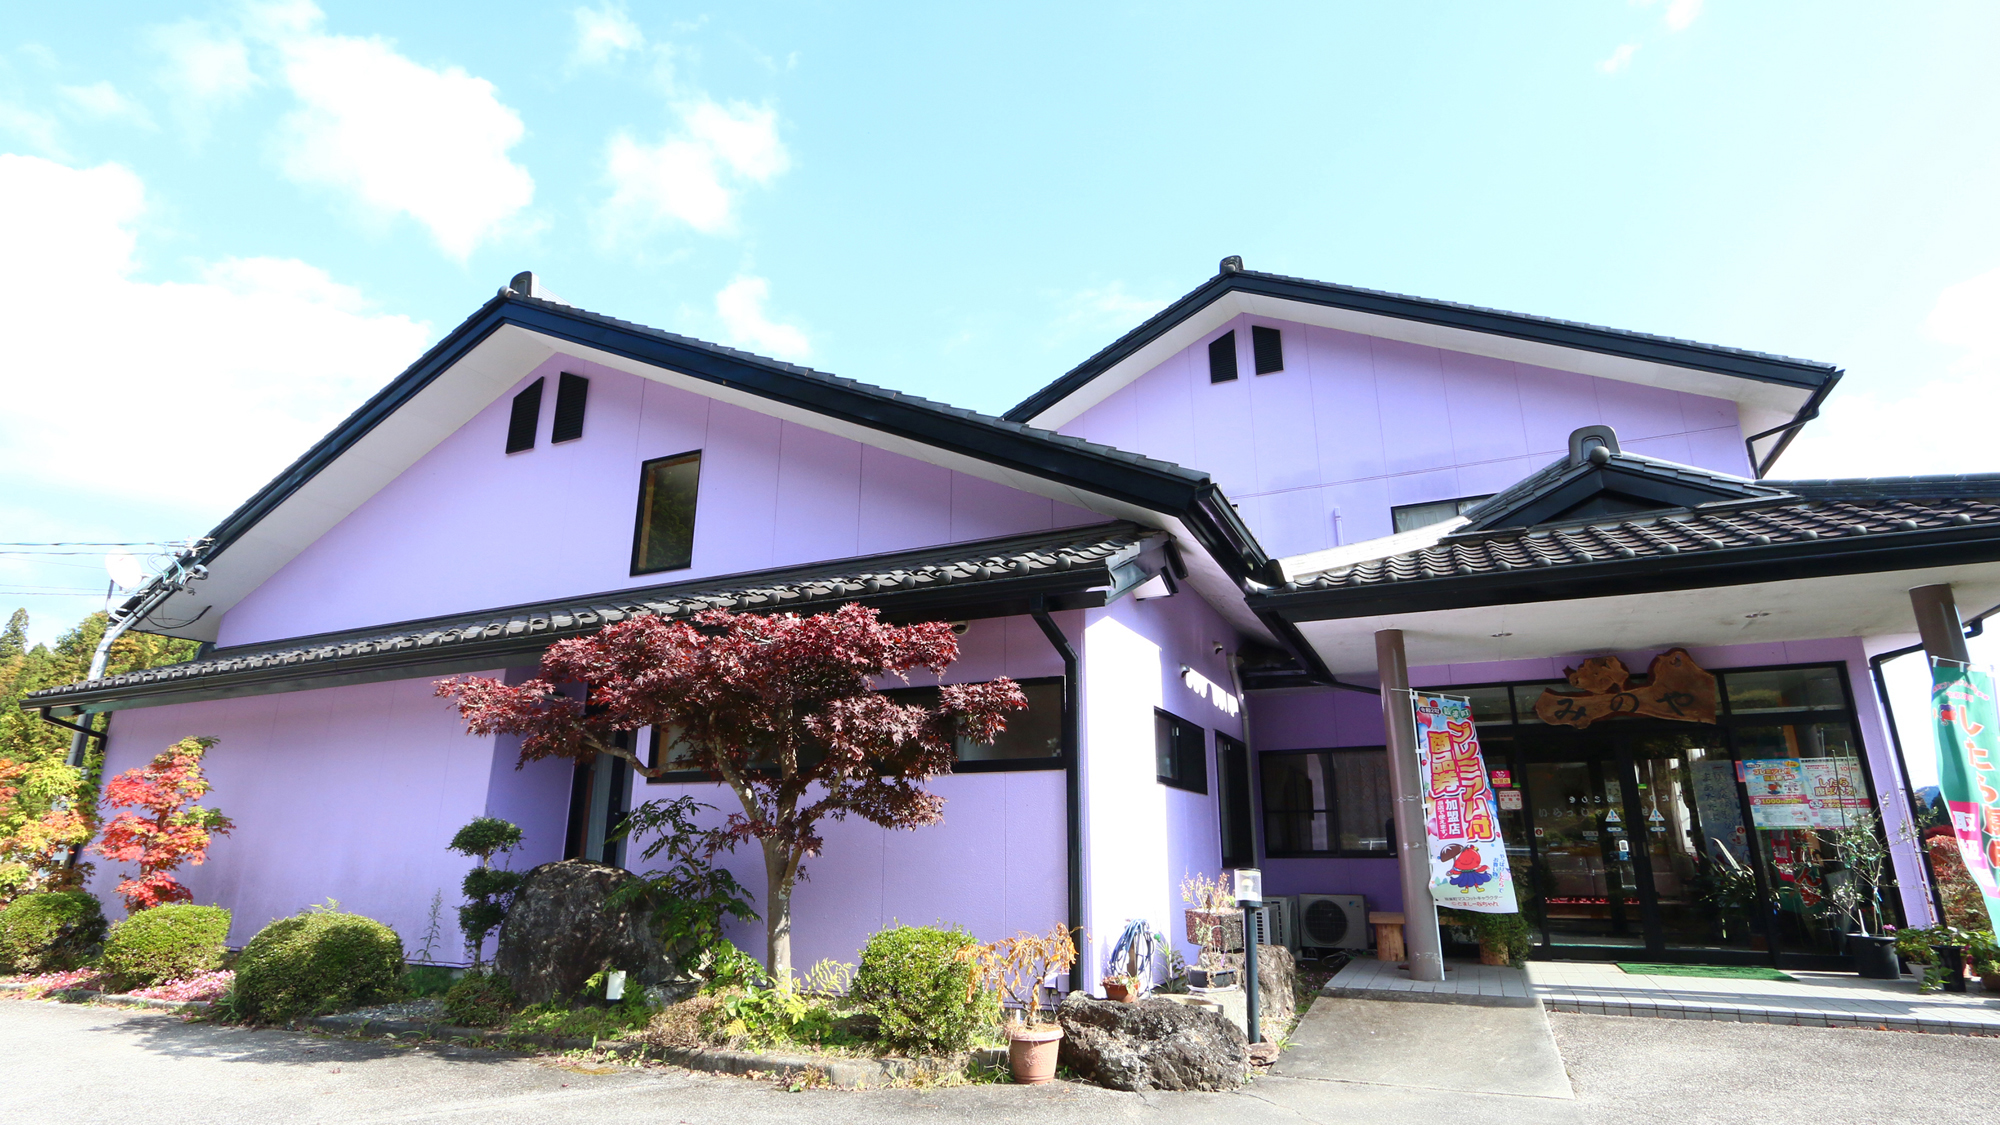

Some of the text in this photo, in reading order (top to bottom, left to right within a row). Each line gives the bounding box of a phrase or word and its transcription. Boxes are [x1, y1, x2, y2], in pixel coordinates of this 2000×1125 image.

[1554, 692, 1694, 721] みのや
[1427, 731, 1460, 796] 商品券
[1446, 721, 1493, 841] プレミアム付
[1445, 799, 1461, 835] 加盟店
